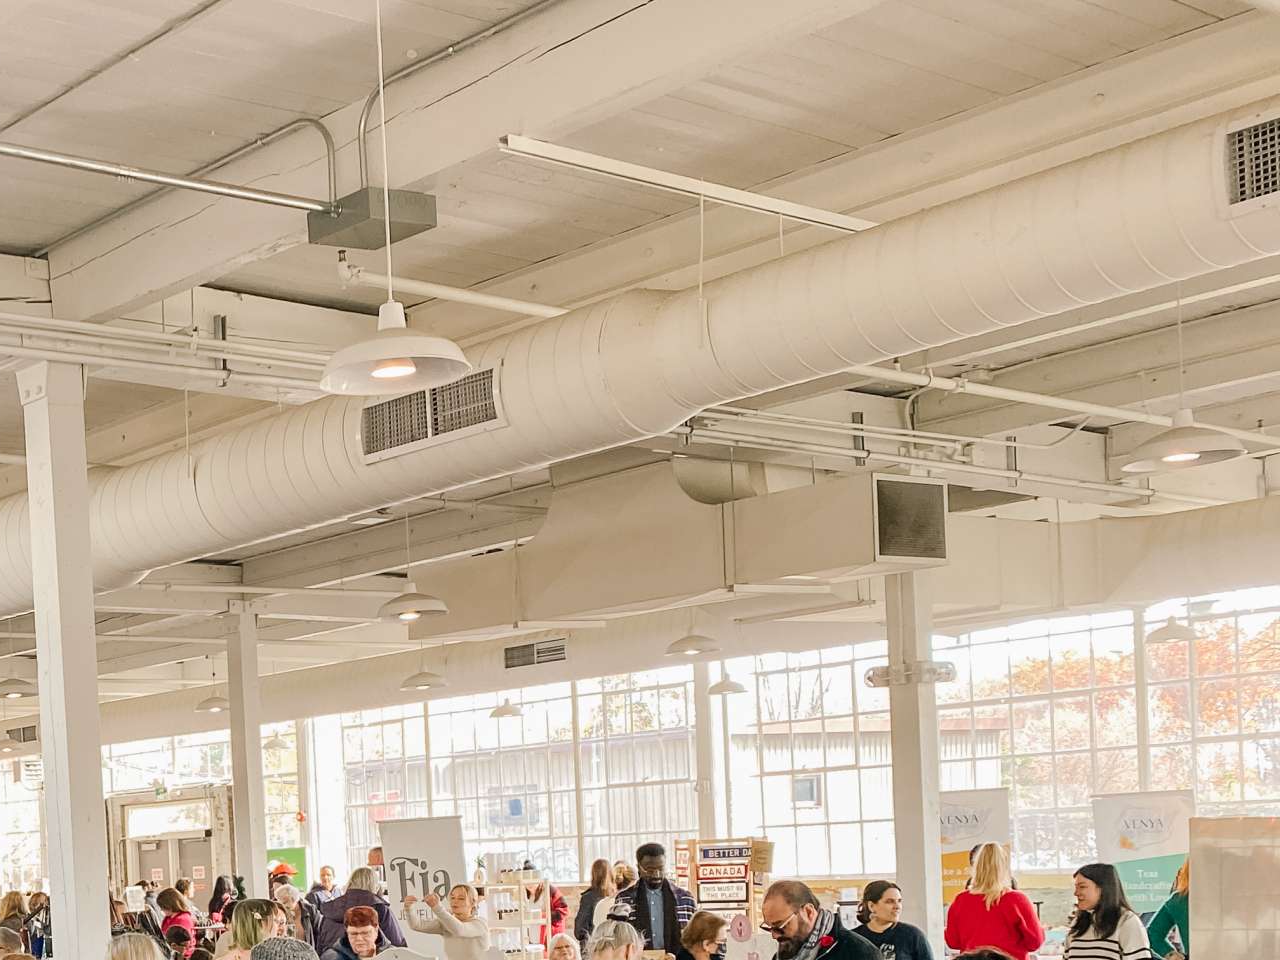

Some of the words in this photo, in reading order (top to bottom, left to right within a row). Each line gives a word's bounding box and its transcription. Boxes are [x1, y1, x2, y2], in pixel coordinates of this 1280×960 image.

[708, 849, 740, 858] BETTER
[742, 848, 752, 857] DA
[702, 867, 743, 877] CANADA
[389, 856, 452, 903] Fia
